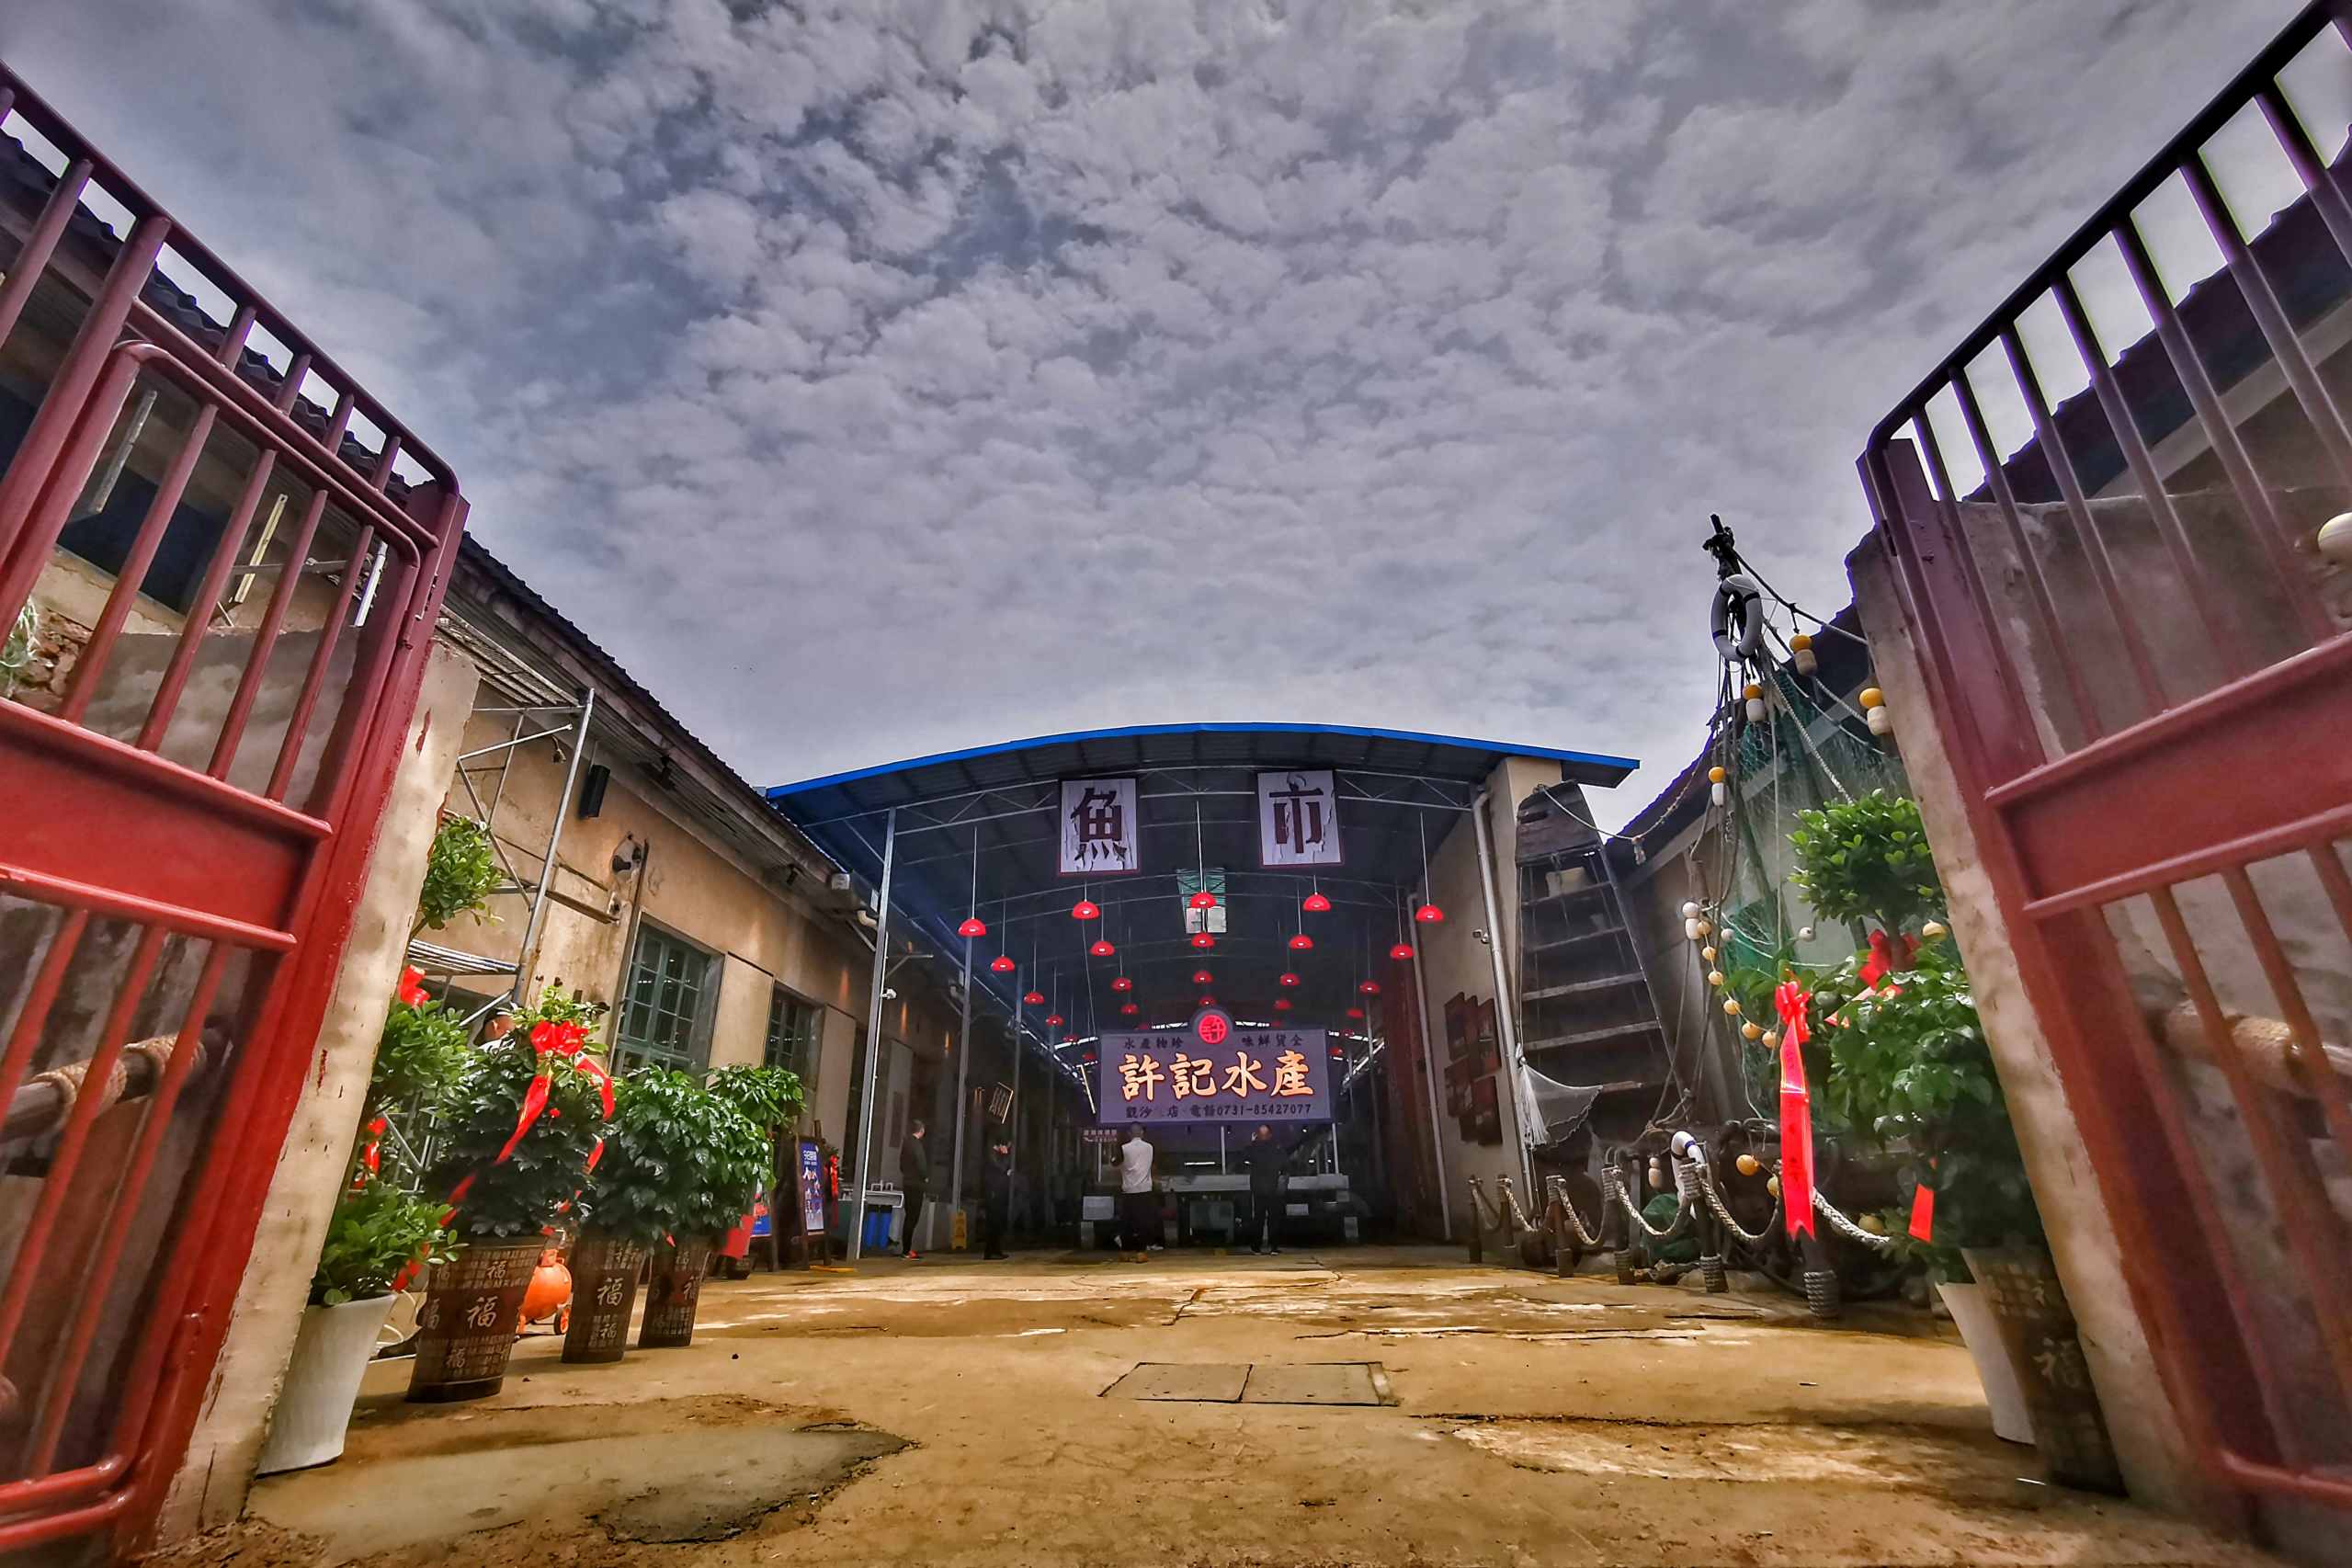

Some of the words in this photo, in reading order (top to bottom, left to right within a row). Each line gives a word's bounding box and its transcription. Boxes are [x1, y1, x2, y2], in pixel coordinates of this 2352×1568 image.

[1070, 787, 1128, 861] 魚
[1268, 773, 1324, 855] 市
[1119, 1050, 1314, 1102] 許記水產
[466, 1296, 499, 1329] 福
